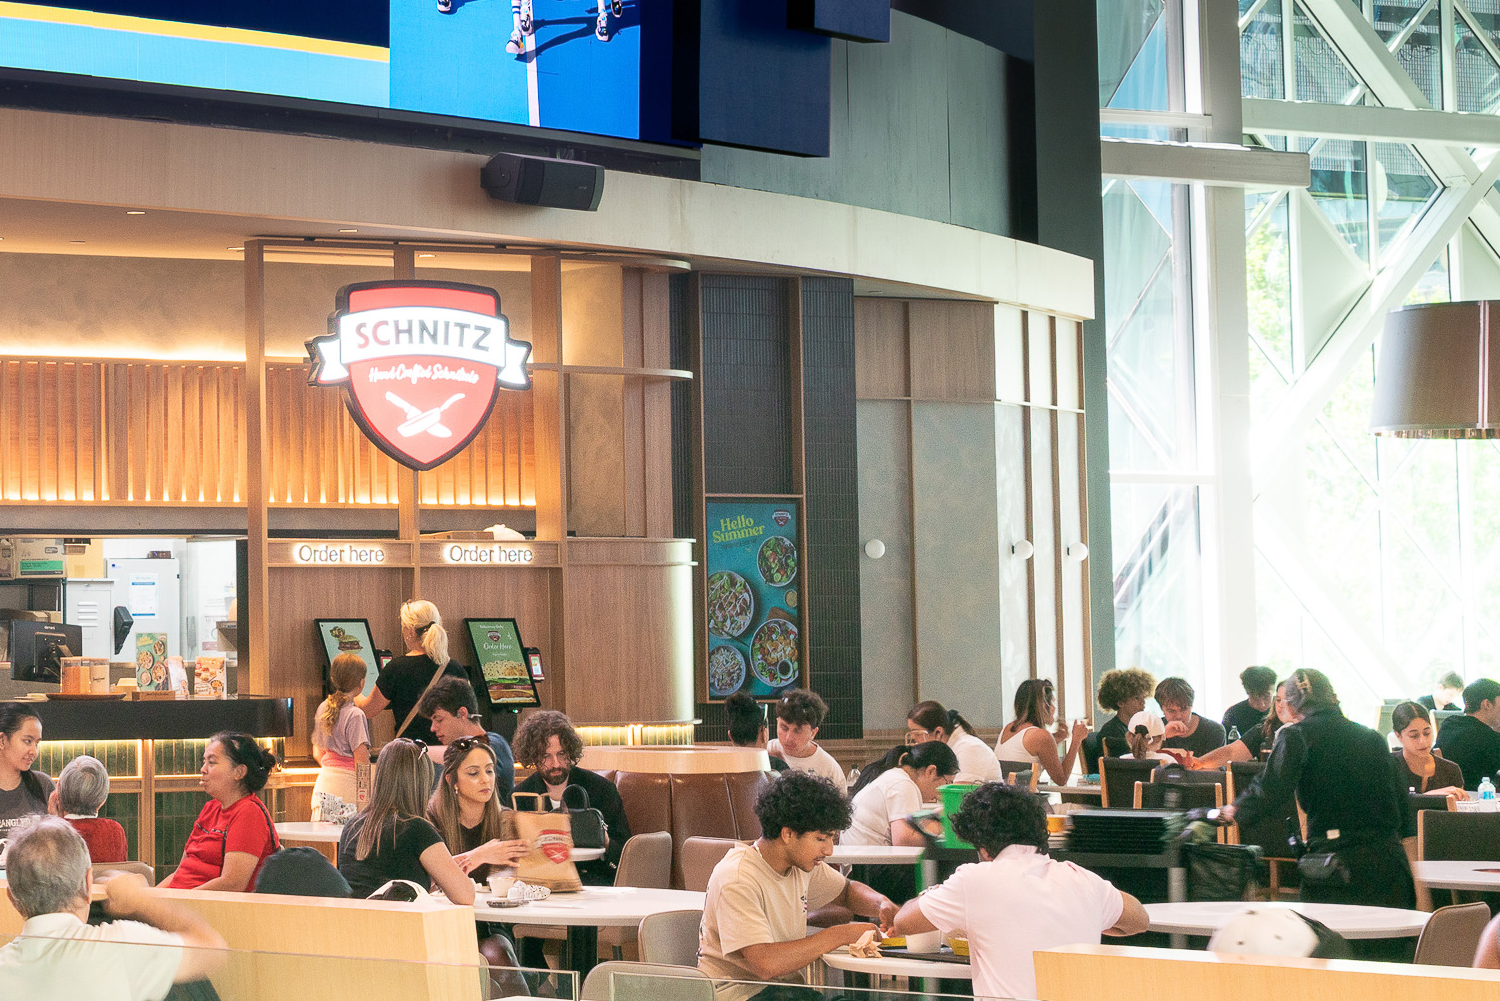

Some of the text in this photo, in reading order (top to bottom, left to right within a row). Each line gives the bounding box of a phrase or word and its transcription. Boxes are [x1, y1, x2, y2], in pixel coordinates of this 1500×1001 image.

[355, 319, 491, 352] SCHNITZ
[720, 515, 754, 531] Hello
[712, 525, 765, 543] Summer
[299, 545, 385, 562] Order here
[450, 545, 533, 562] Order here
